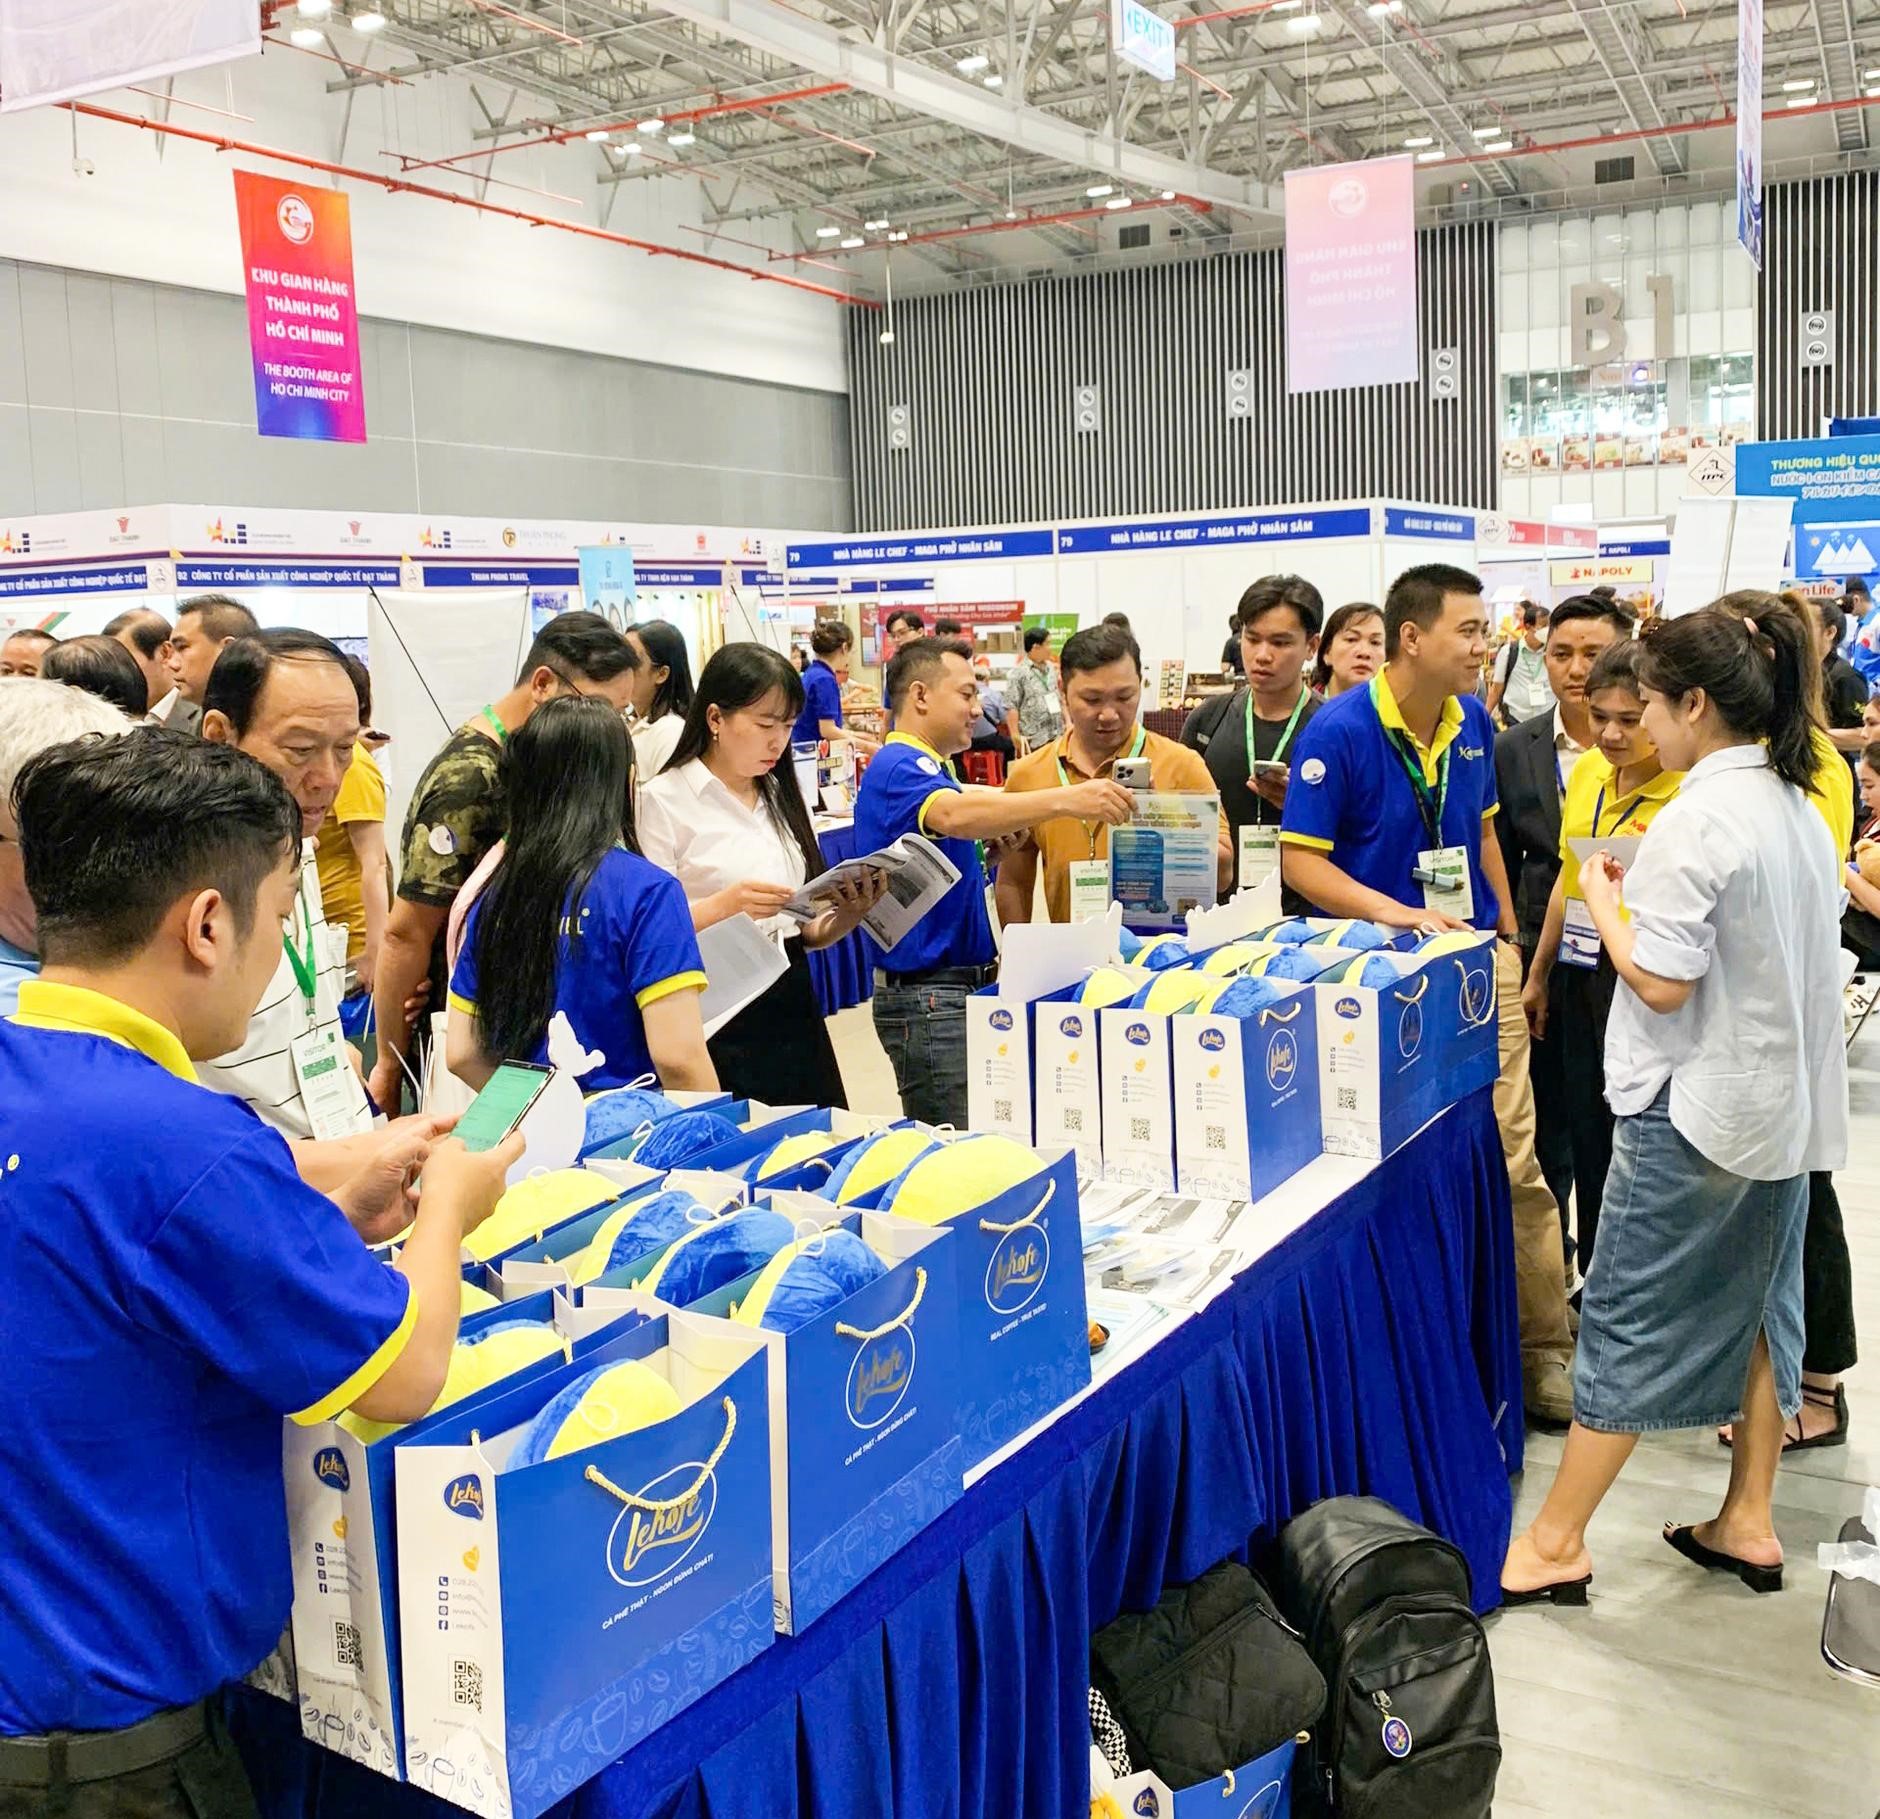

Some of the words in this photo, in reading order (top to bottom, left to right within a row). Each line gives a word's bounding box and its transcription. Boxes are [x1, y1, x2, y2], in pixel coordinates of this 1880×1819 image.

[251, 267, 278, 285] KHU
[280, 272, 312, 290] GIAN
[313, 277, 348, 297] HÀNG
[265, 295, 311, 316] THÀNH
[313, 303, 339, 321] PHỐ
[1571, 274, 1675, 366] B1
[288, 324, 309, 341] CHÍ
[311, 329, 344, 346] MINH
[264, 362, 282, 376] THE
[283, 364, 316, 380] BOOTH
[317, 370, 338, 384] AREA
[341, 372, 352, 384] OF
[271, 383, 286, 396] HO
[287, 384, 303, 397] CHI
[304, 387, 328, 400] MINH
[329, 389, 349, 402] CITY
[1771, 457, 1823, 470] THƯƠNG
[1826, 453, 1856, 468] HIỆU
[1132, 529, 1159, 543] HÀNG
[1160, 530, 1172, 541] LE
[1174, 528, 1199, 541] CHEF
[1260, 520, 1288, 535] NHÂN
[851, 547, 874, 559] HÀNG
[874, 548, 886, 558] LE
[886, 546, 908, 558] CHEF
[191, 569, 212, 581] CÔNG
[212, 571, 223, 580] TY
[613, 1605, 629, 1625] PHÊ
[629, 1593, 650, 1612] THẬT
[652, 1579, 673, 1599] NGON
